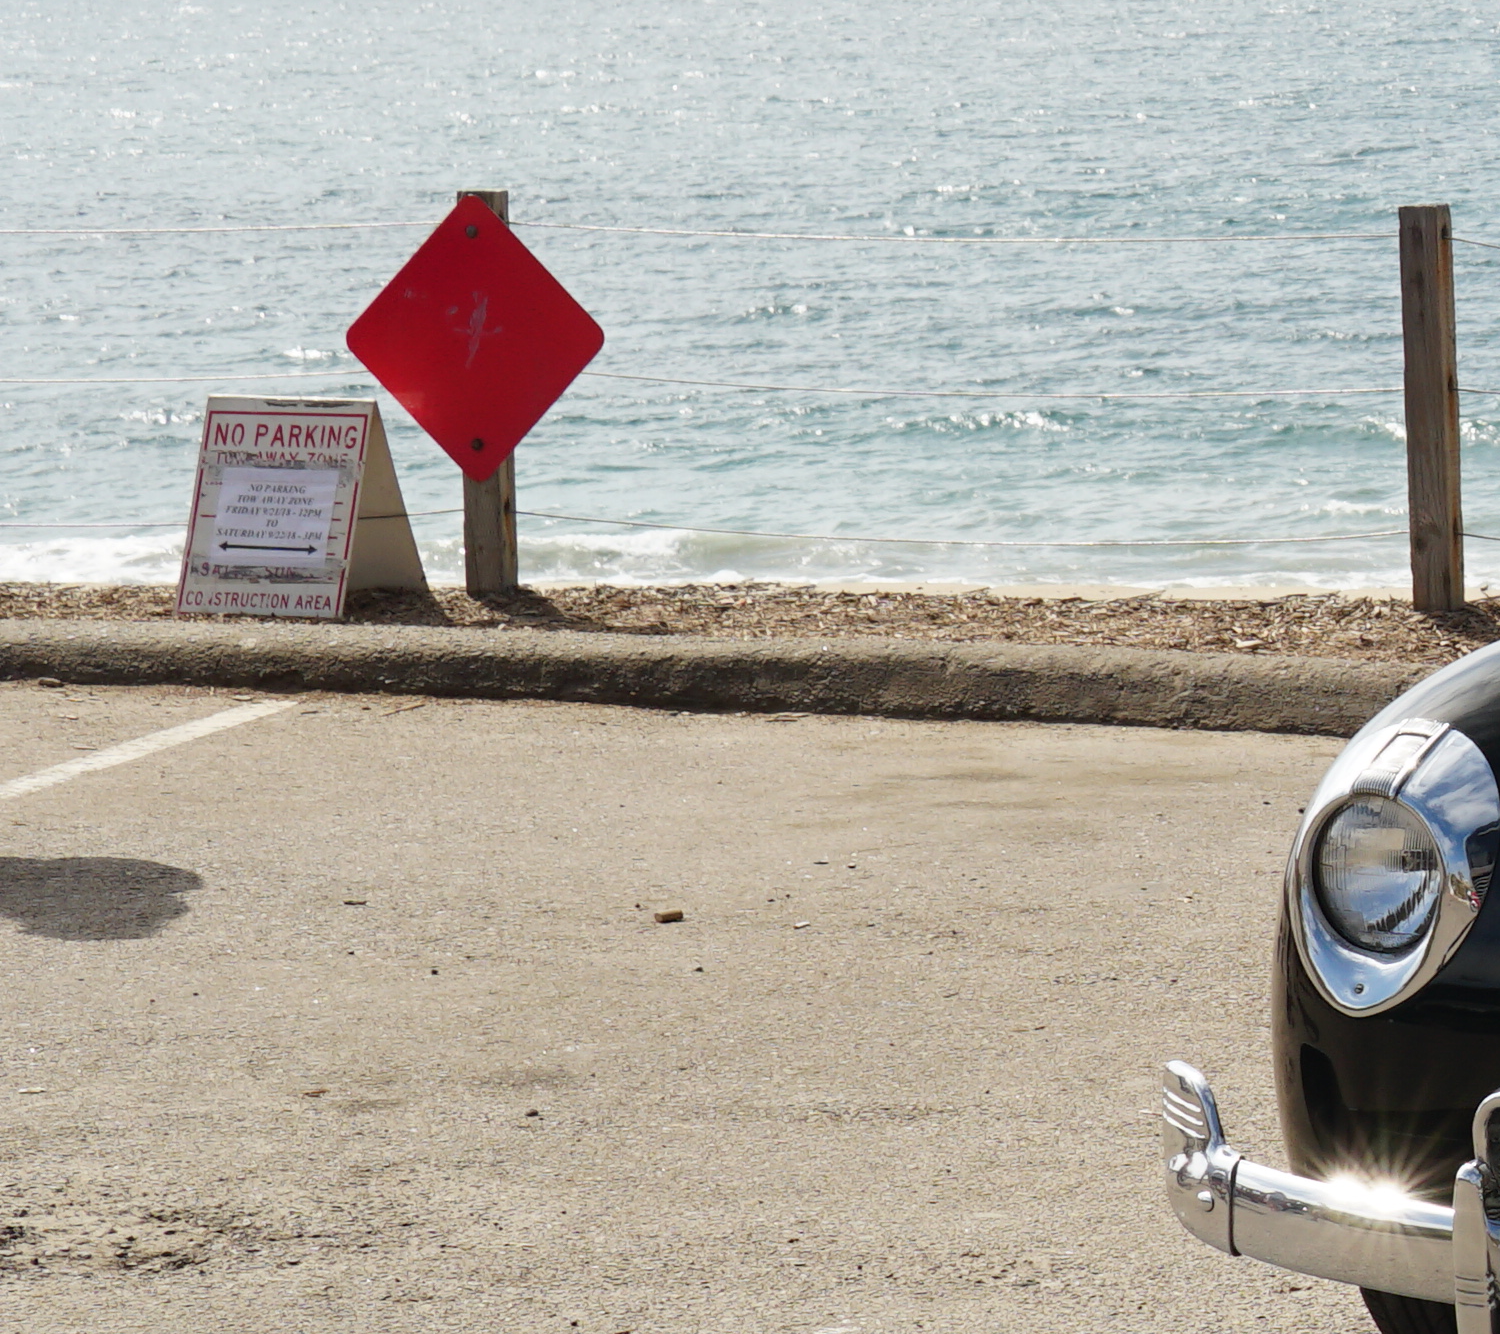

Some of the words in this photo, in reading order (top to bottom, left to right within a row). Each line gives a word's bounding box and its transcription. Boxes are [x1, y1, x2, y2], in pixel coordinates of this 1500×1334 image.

[214, 423, 245, 447] NO
[254, 423, 358, 449] PARKING
[249, 484, 263, 492] NO
[264, 485, 306, 494] PARKING
[237, 494, 257, 503] TOW
[288, 496, 315, 505] ZONE
[225, 505, 260, 516] FRIDAY
[265, 519, 279, 528] TO
[216, 528, 266, 539] SATURDAY
[294, 595, 332, 611] AREA
